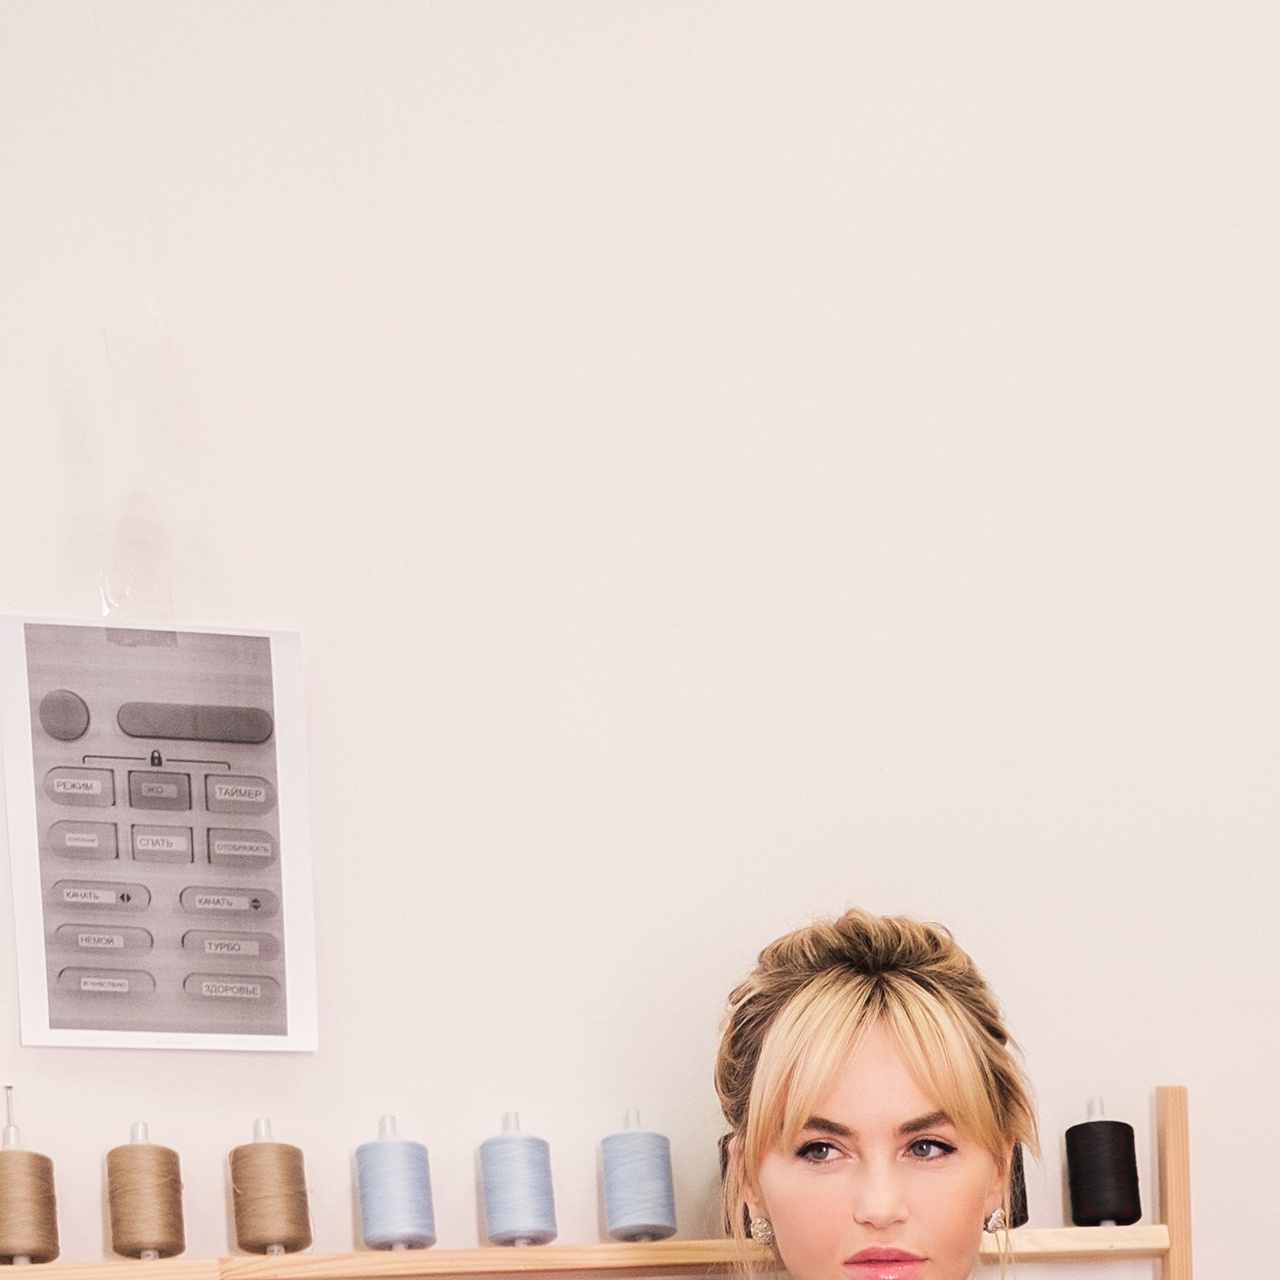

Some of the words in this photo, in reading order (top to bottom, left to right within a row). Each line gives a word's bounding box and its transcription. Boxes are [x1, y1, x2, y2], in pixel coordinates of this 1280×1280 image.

[56, 781, 94, 791] РЕЖИМ
[217, 786, 262, 798] ТАЙМЕР
[139, 838, 173, 848] СПАТЬ
[80, 936, 114, 946] НЕМОЙ
[207, 942, 241, 952] ТУРБО
[204, 984, 257, 995] ЗДОРОВЬЕ
